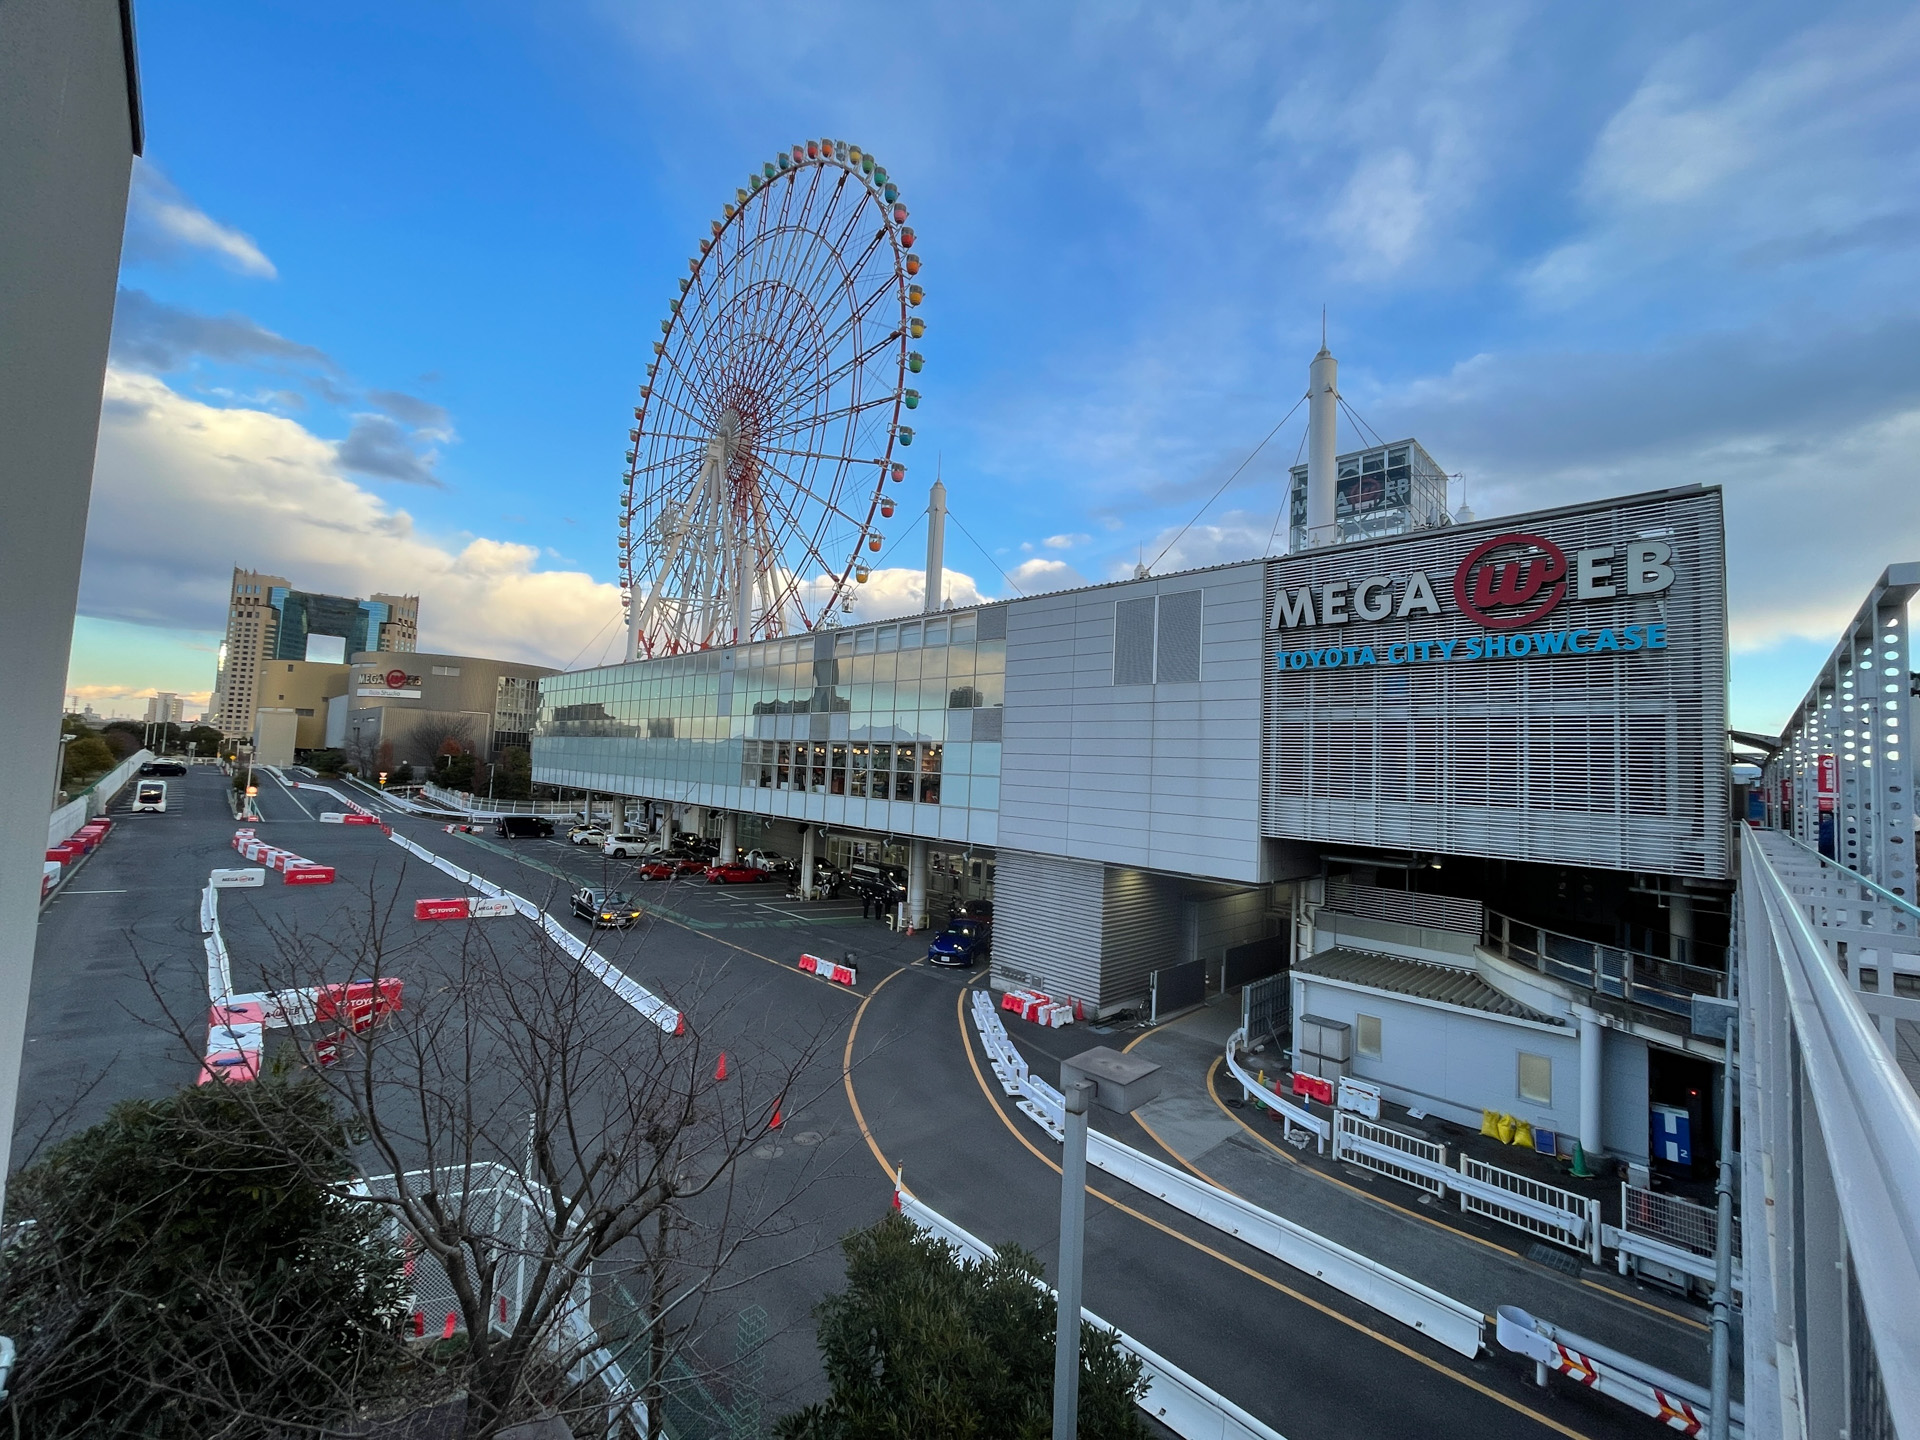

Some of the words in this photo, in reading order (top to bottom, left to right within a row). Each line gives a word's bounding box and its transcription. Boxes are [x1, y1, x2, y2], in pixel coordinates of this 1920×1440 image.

[1269, 569, 1442, 630] MEGA
[1275, 645, 1377, 671] TOYOTA
[1387, 638, 1459, 665] CITY
[1465, 622, 1668, 660] SHOWCASE
[358, 674, 385, 684] MEGA
